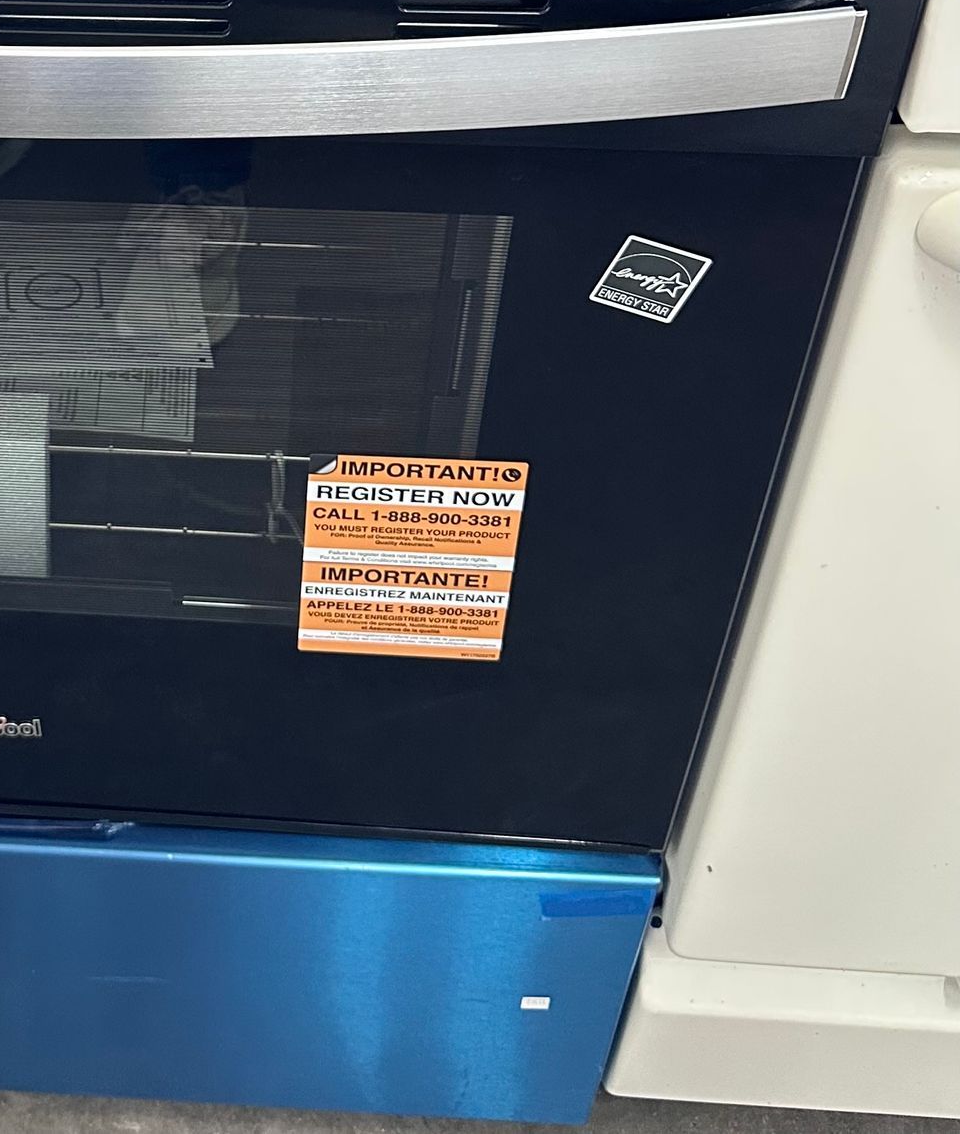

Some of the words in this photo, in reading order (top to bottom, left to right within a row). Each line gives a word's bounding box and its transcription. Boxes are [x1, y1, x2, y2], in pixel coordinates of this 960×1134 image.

[597, 288, 642, 308] ENERGY
[640, 302, 670, 317] STAR
[341, 461, 499, 482] IMPORTANT!
[316, 485, 445, 505] REGISTER
[453, 491, 516, 507] NOW
[312, 507, 365, 521] CALL
[371, 510, 512, 528] 1-888-900-3381
[340, 525, 369, 533] MUST
[370, 526, 424, 536] REGISTER
[426, 528, 456, 537] YOUR
[458, 530, 512, 540] PRODUCT
[320, 567, 489, 588] IMPORTANTE!
[305, 585, 406, 599] ENREGISTREZ
[409, 591, 506, 604] MAINTENANT
[306, 600, 373, 612] APPELEZ
[376, 603, 393, 613] LE
[398, 605, 499, 618] 1-888-900-3381
[334, 612, 363, 620] DEVEZ
[365, 614, 427, 623] ENREGISTRER
[428, 617, 459, 625] VOTRE
[460, 618, 500, 626] PRODUIT
